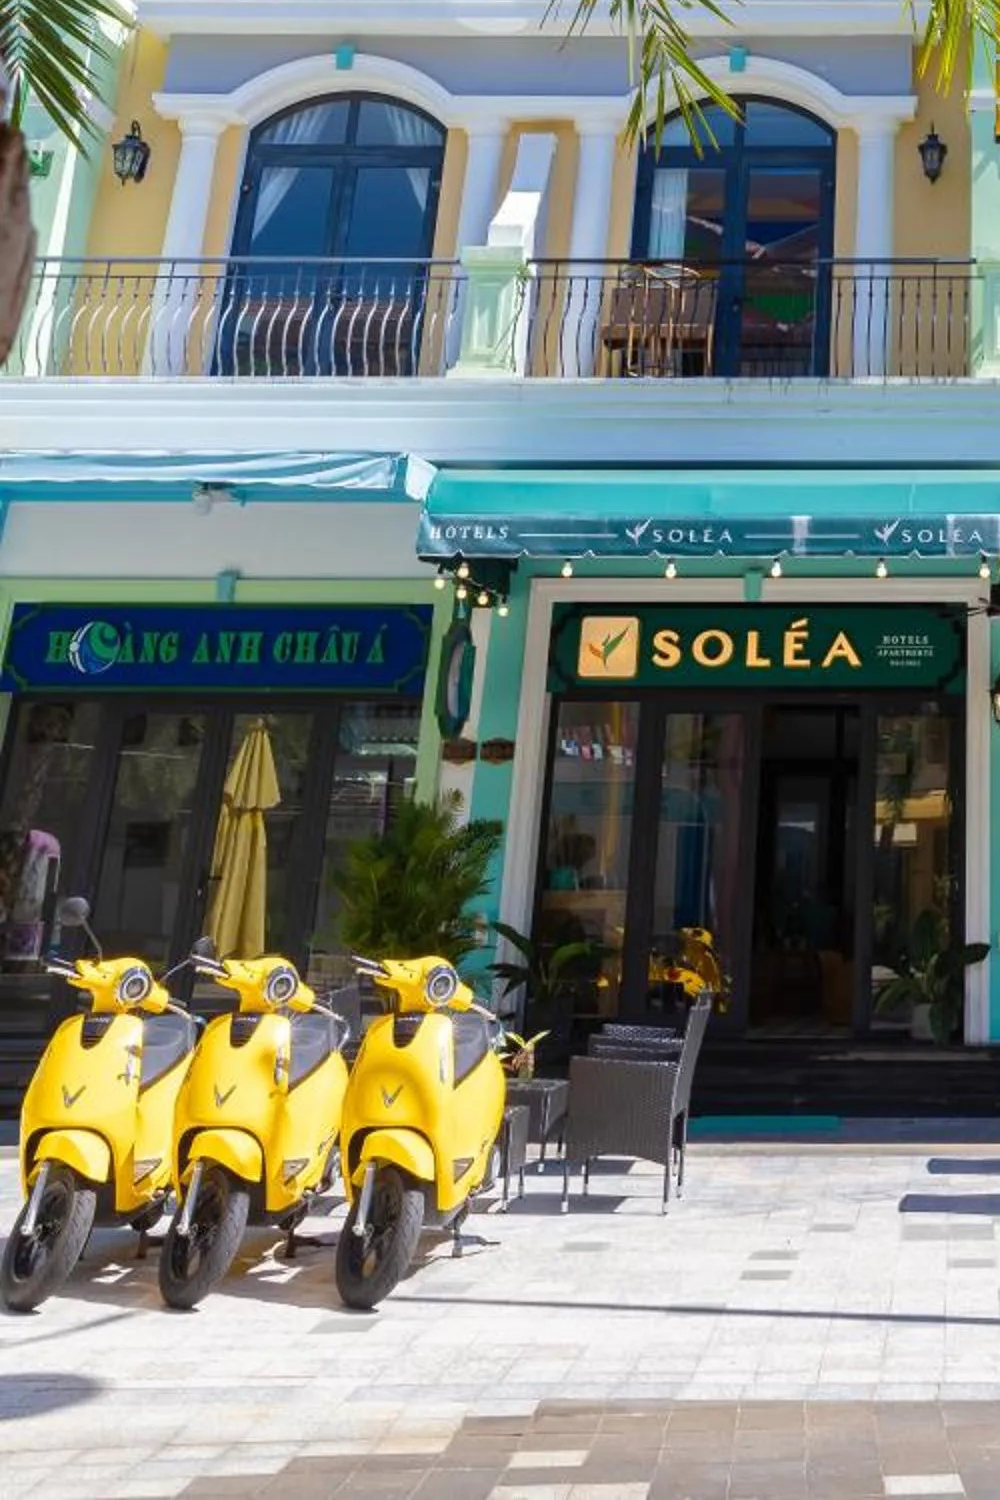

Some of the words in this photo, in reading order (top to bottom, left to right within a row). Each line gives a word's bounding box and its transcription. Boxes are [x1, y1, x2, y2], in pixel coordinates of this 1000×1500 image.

[430, 524, 510, 541] HOTELS
[653, 525, 734, 544] SOLÉA
[901, 525, 984, 544] SOLÉA
[192, 631, 264, 664] ANH
[272, 624, 362, 664] CHÂU
[366, 623, 389, 664] Á
[652, 618, 862, 668] SOLÉA
